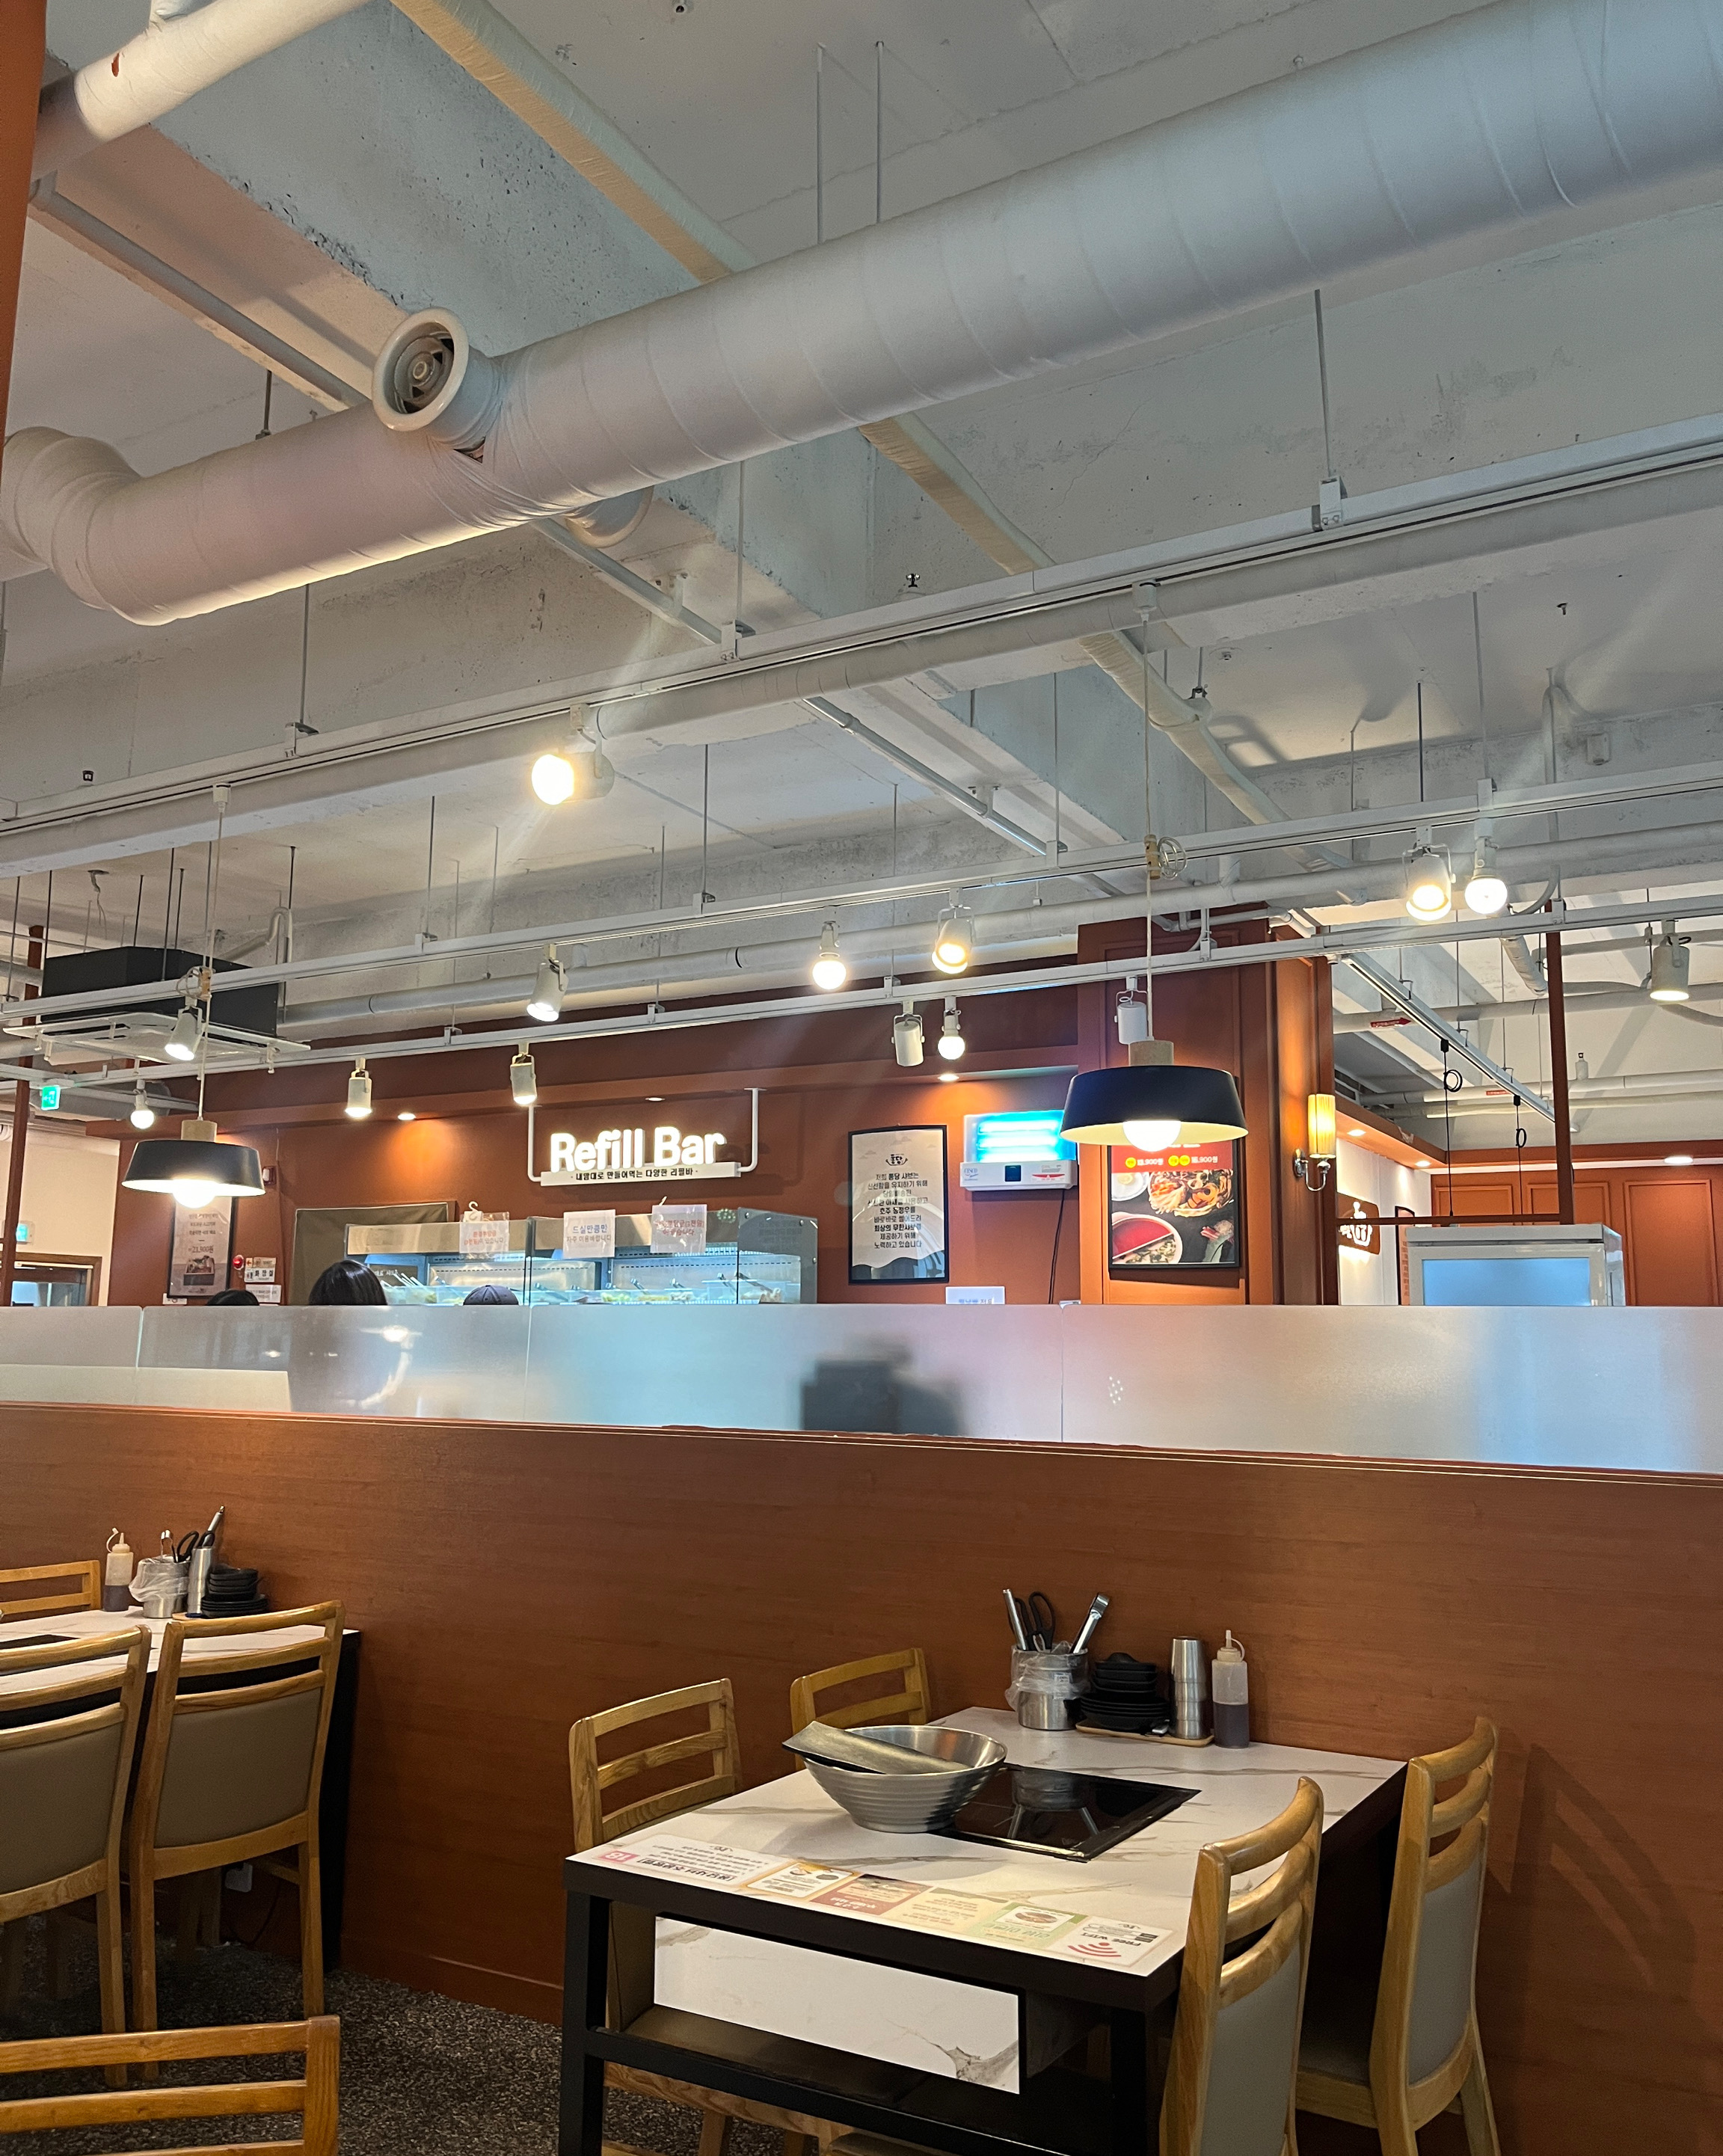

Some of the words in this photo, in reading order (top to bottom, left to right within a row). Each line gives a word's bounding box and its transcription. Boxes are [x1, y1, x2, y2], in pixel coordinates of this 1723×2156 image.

[550, 1128, 644, 1173] Refill
[654, 1126, 727, 1167] Bar
[606, 1170, 642, 1179] 만들어먹는
[645, 1168, 668, 1177] 다양한
[670, 1167, 693, 1176] 리필바
[867, 1182, 889, 1190] 신선함을
[573, 1224, 607, 1234] 드실만큼만
[604, 1852, 632, 1861] 18
[1111, 1938, 1141, 1947] FREE
